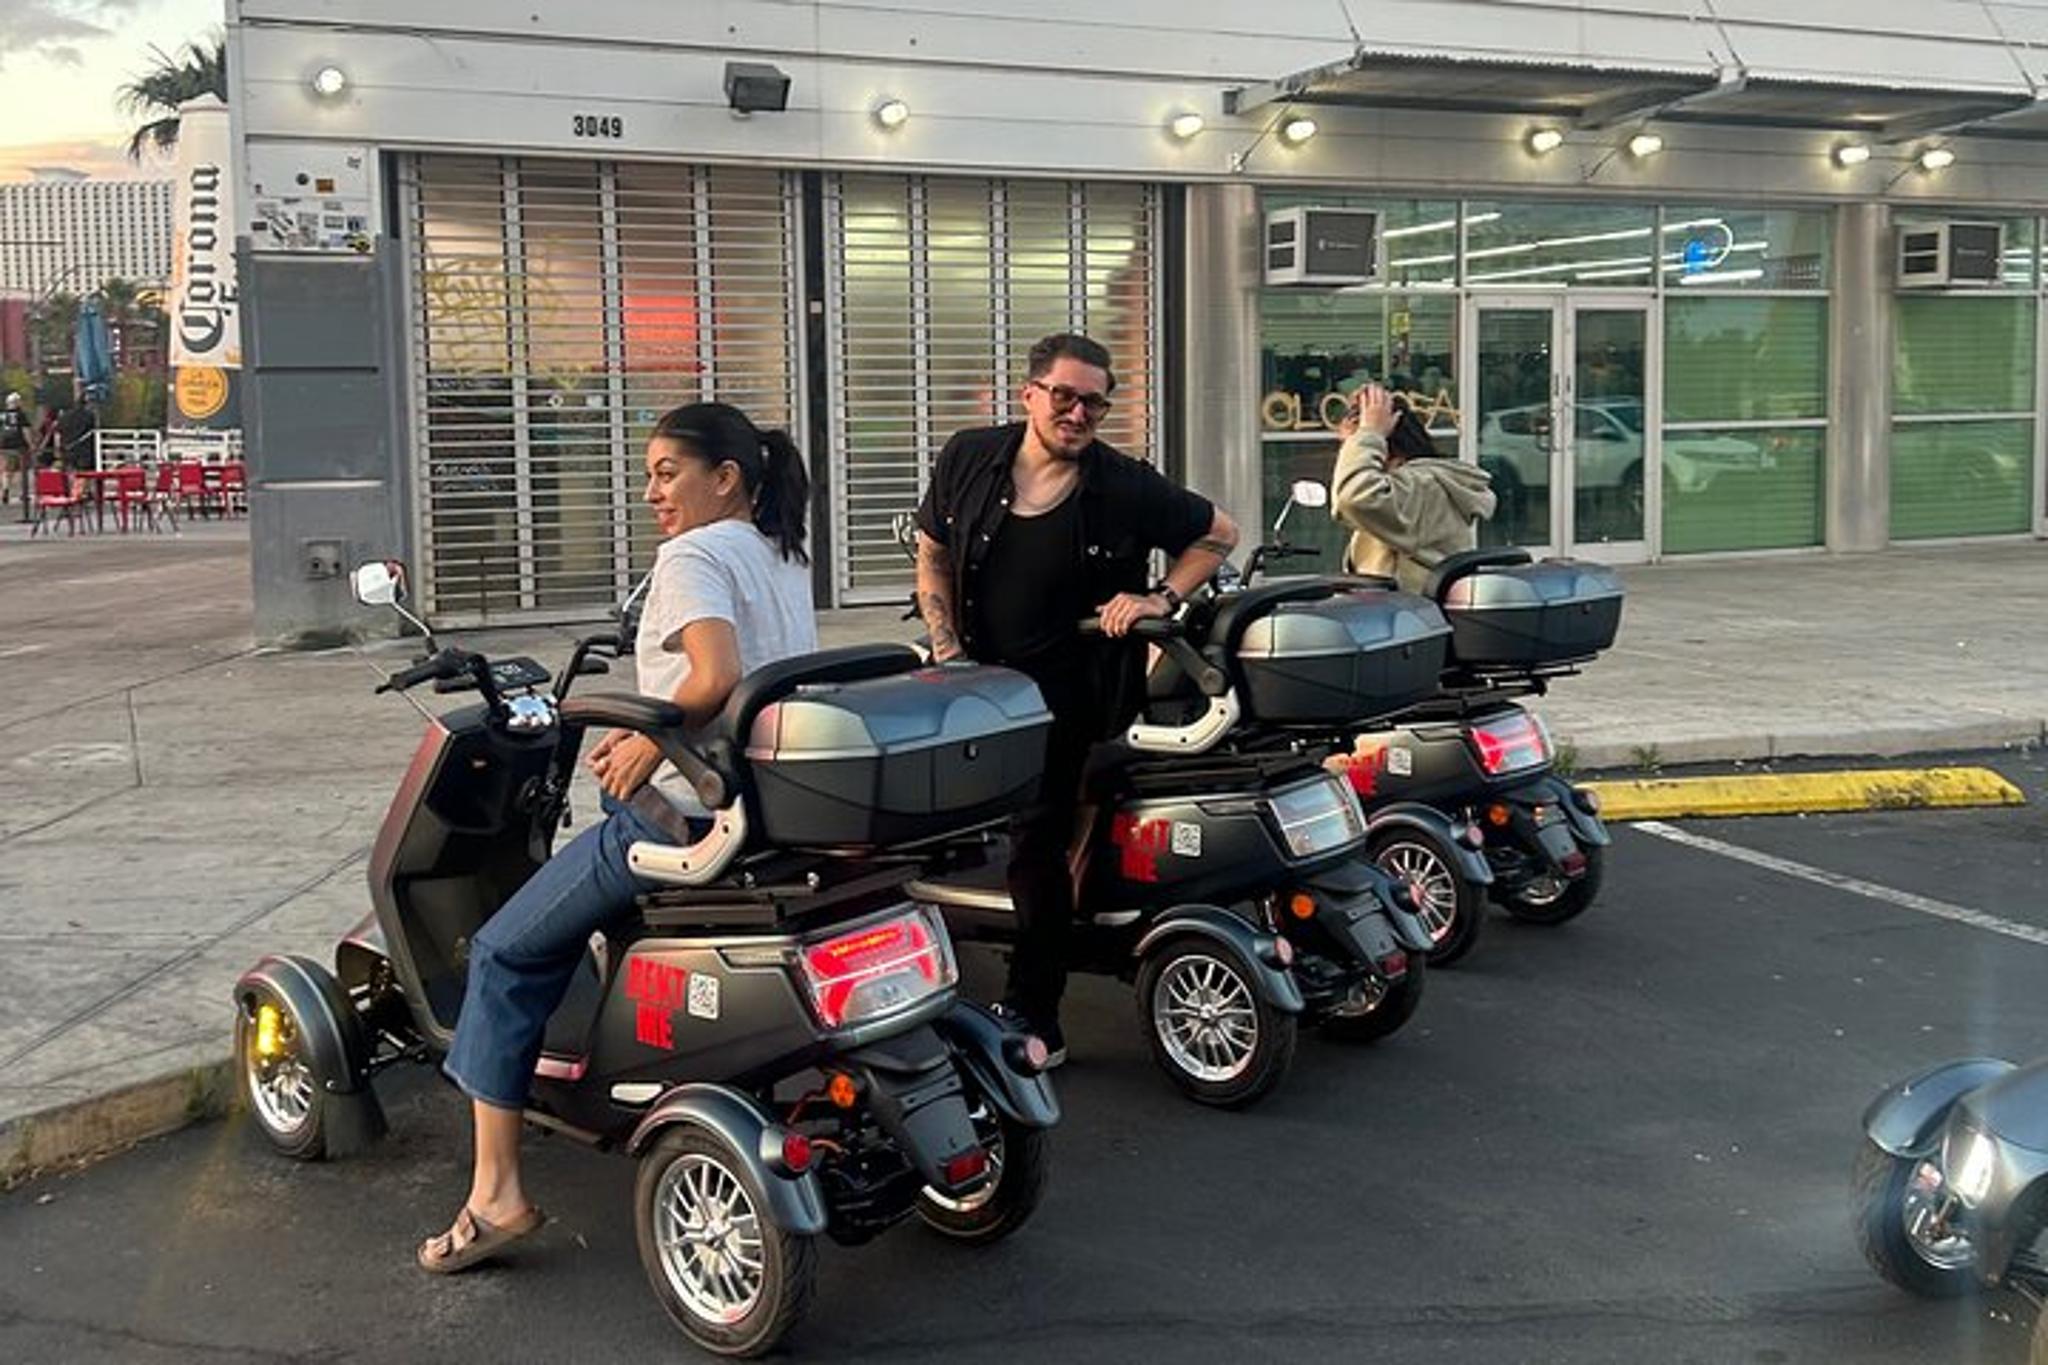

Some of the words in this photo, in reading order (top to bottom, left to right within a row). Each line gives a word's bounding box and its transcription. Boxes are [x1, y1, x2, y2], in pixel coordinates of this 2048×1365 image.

[573, 114, 623, 138] 3049
[179, 166, 226, 354] Corona
[625, 955, 686, 1010] RENT
[636, 1000, 674, 1051] ME
